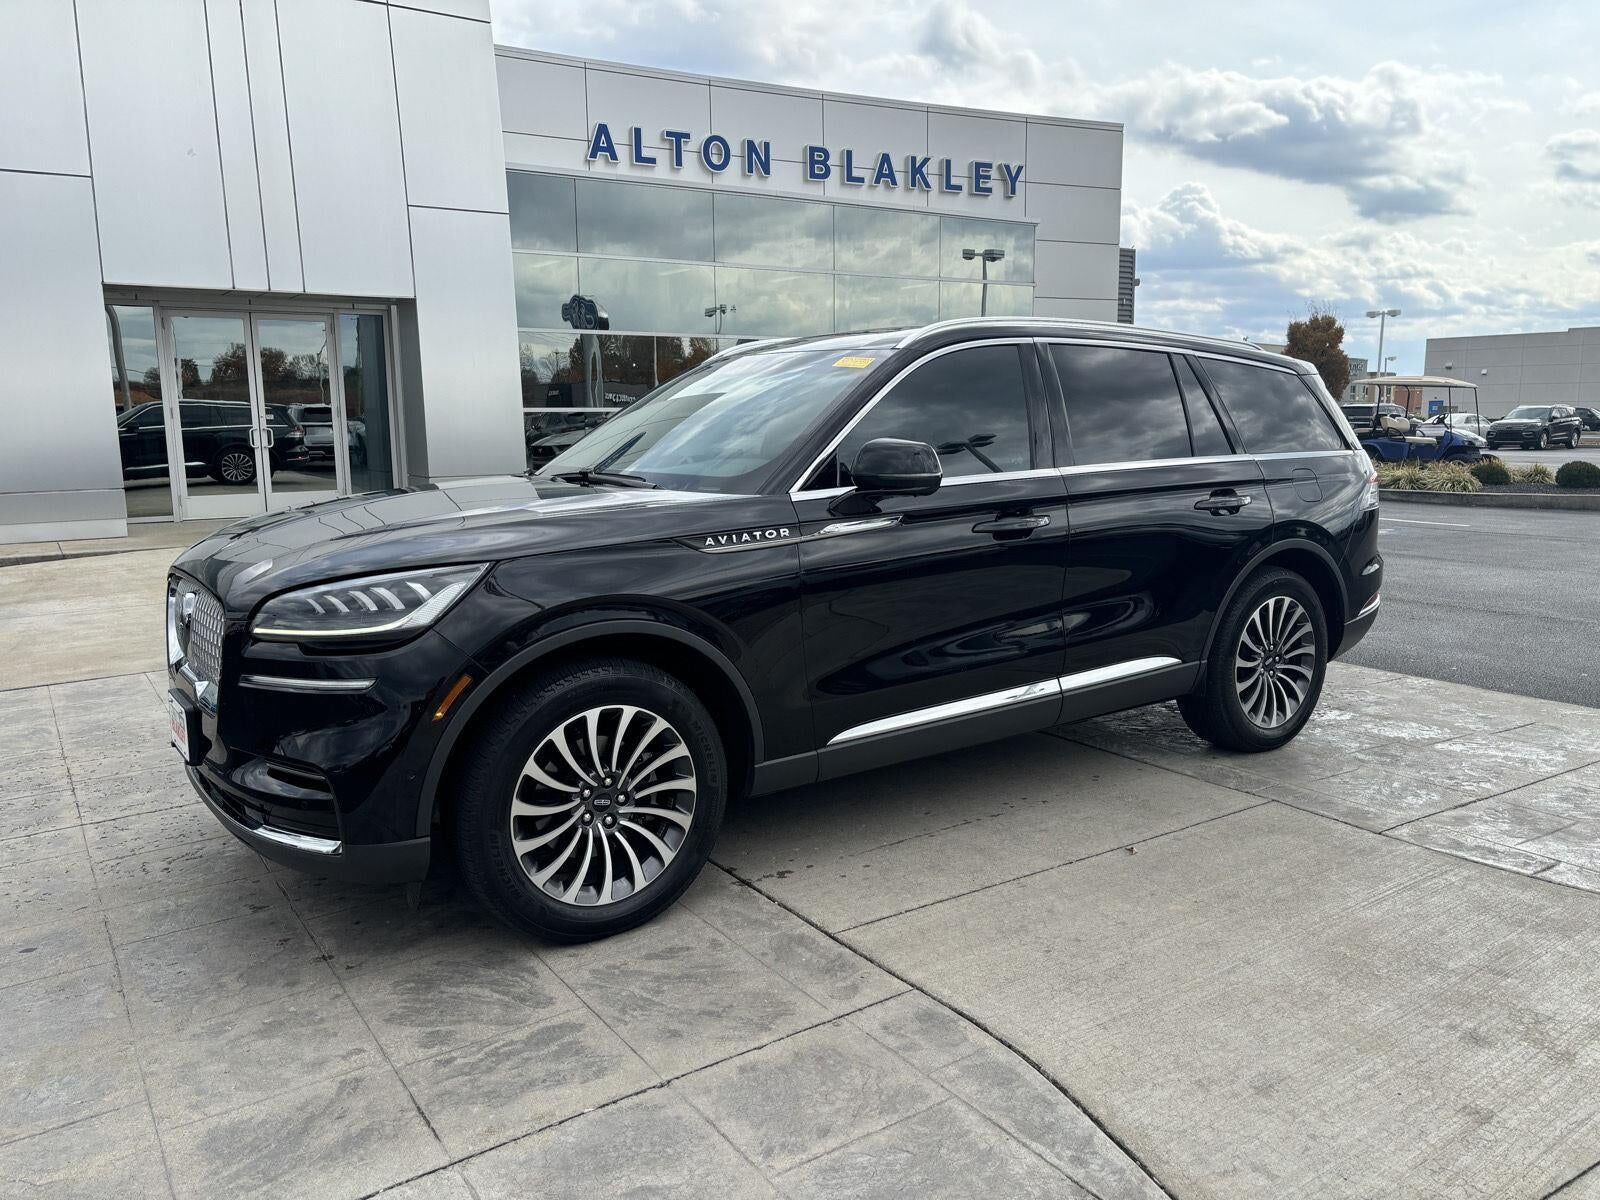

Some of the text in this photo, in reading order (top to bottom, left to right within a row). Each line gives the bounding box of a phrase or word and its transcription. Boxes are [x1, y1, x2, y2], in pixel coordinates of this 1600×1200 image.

[588, 122, 1024, 197] ALTON BLAKLEY
[704, 528, 790, 546] AVIATOR
